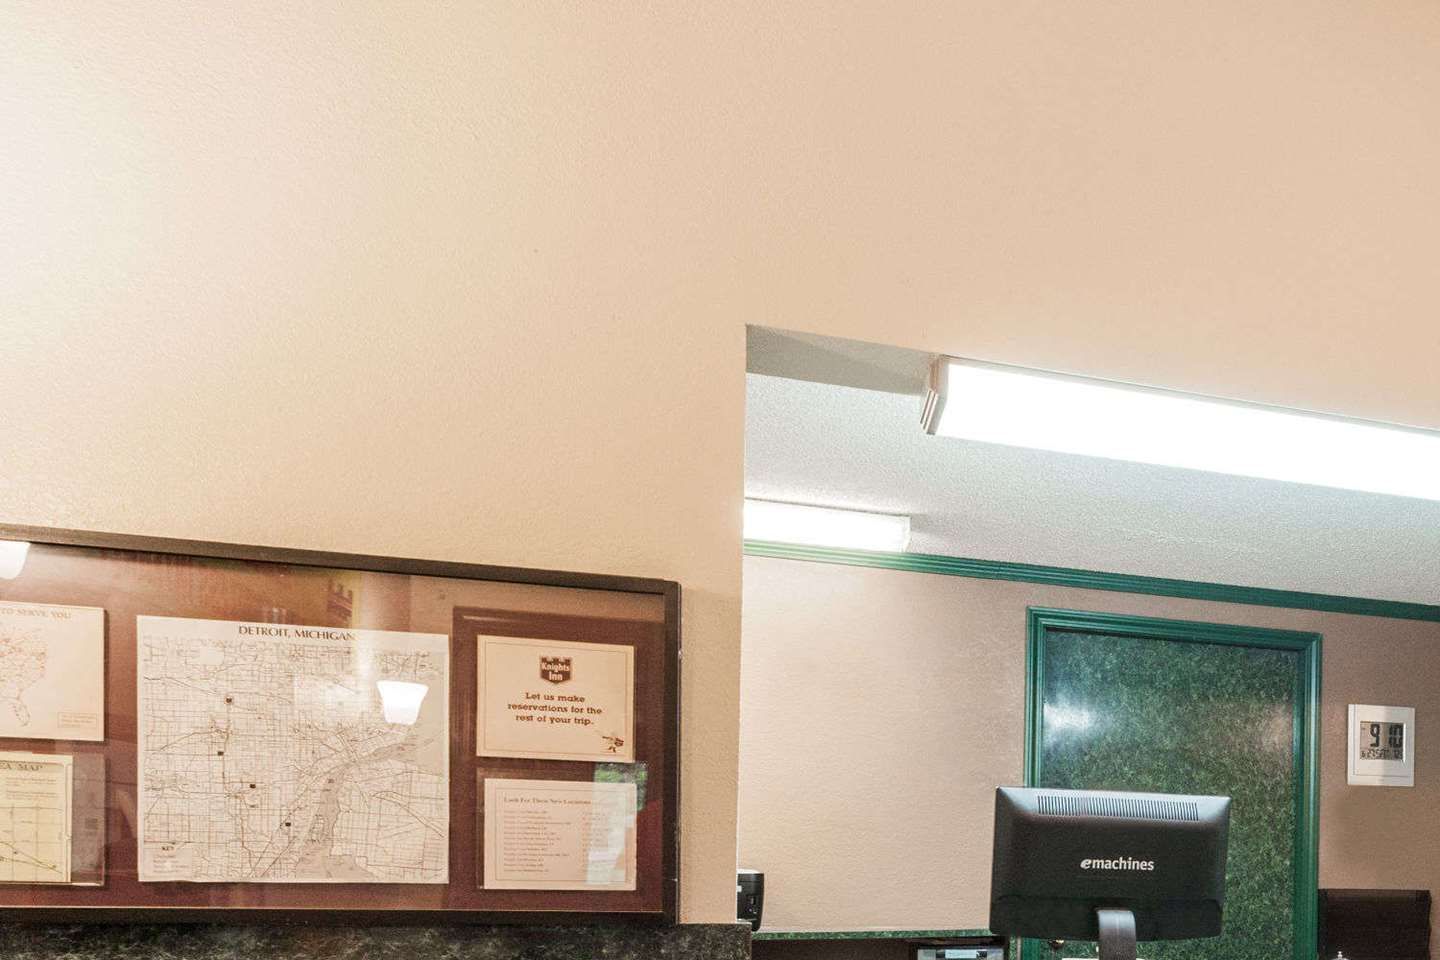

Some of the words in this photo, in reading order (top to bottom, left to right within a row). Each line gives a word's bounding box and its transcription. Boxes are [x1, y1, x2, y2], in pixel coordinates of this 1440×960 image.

[239, 625, 292, 638] DETROIT,
[294, 629, 356, 640] MICHIGAN
[541, 662, 570, 672] Knights
[549, 672, 563, 681] Inn
[525, 692, 541, 700] Let
[557, 695, 585, 703] make
[508, 703, 568, 713] reservations
[571, 706, 584, 714] for
[586, 707, 603, 715] the
[516, 714, 533, 722] rest
[536, 715, 547, 723] of
[574, 716, 594, 726] trip.
